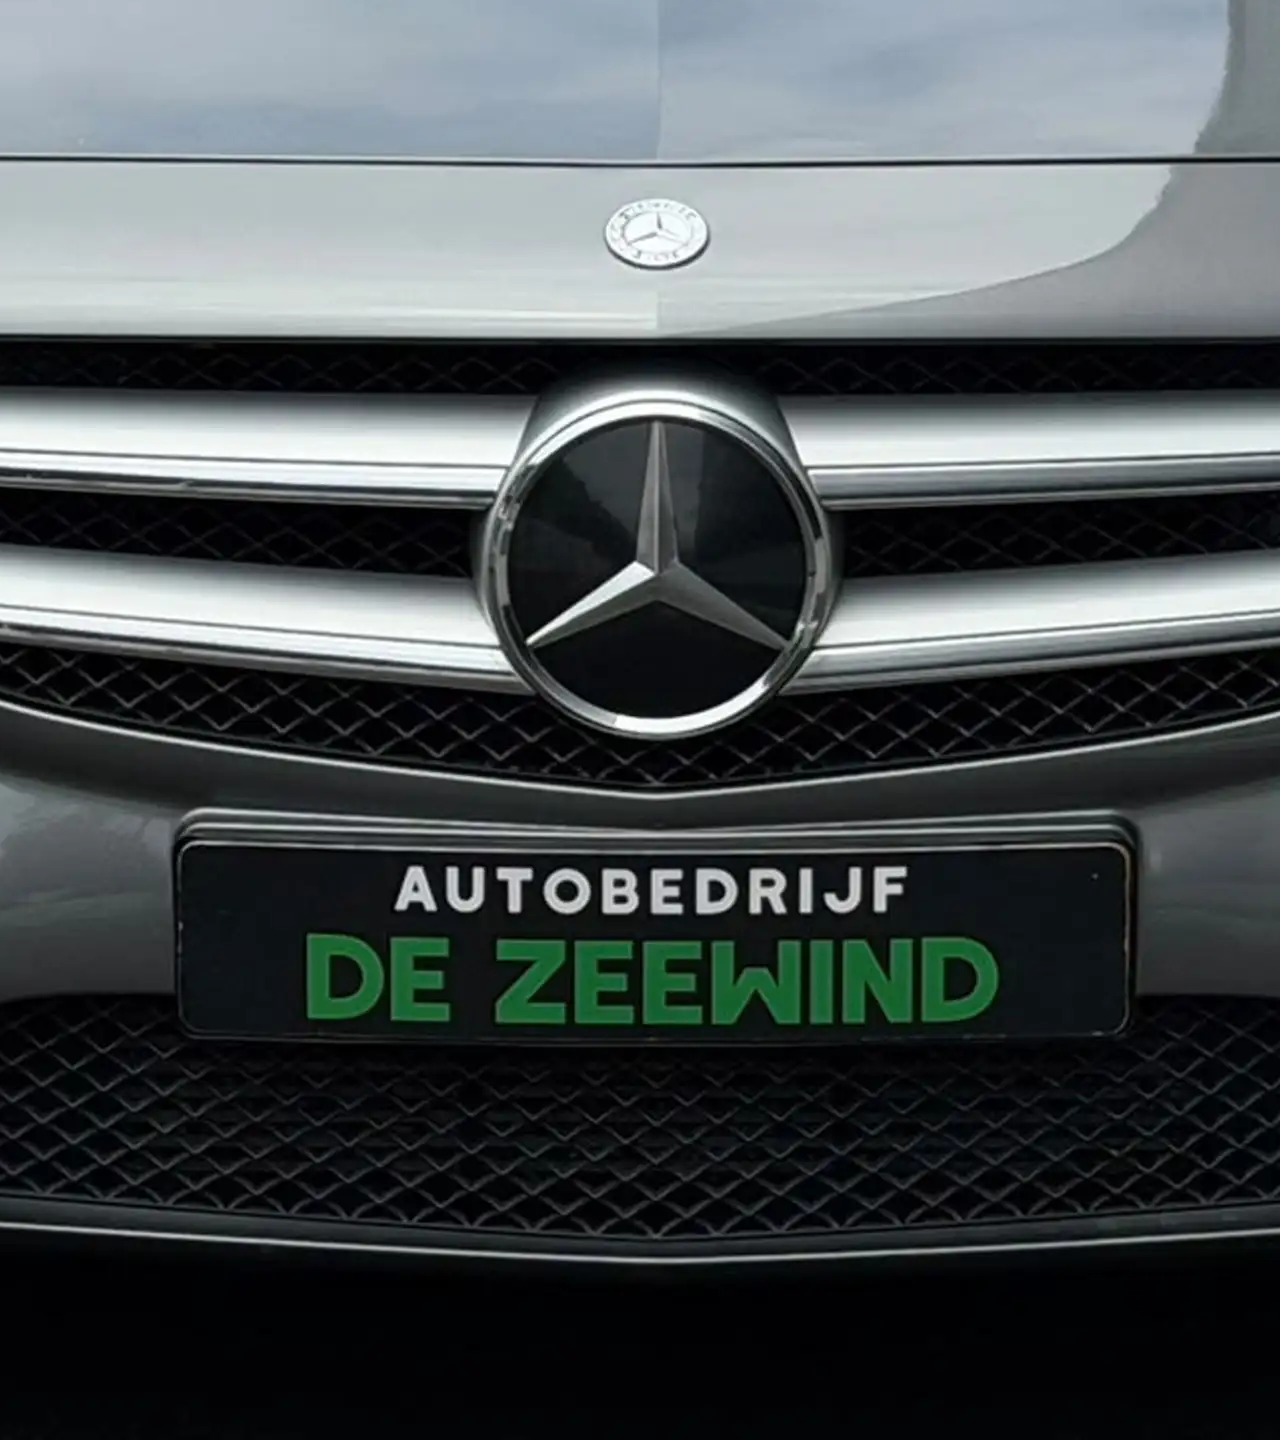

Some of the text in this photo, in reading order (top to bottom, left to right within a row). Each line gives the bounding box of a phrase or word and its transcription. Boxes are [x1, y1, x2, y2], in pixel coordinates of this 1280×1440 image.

[393, 865, 908, 915] AUTOBEDRIJF
[306, 934, 1000, 1027] DE ZEEWIND
